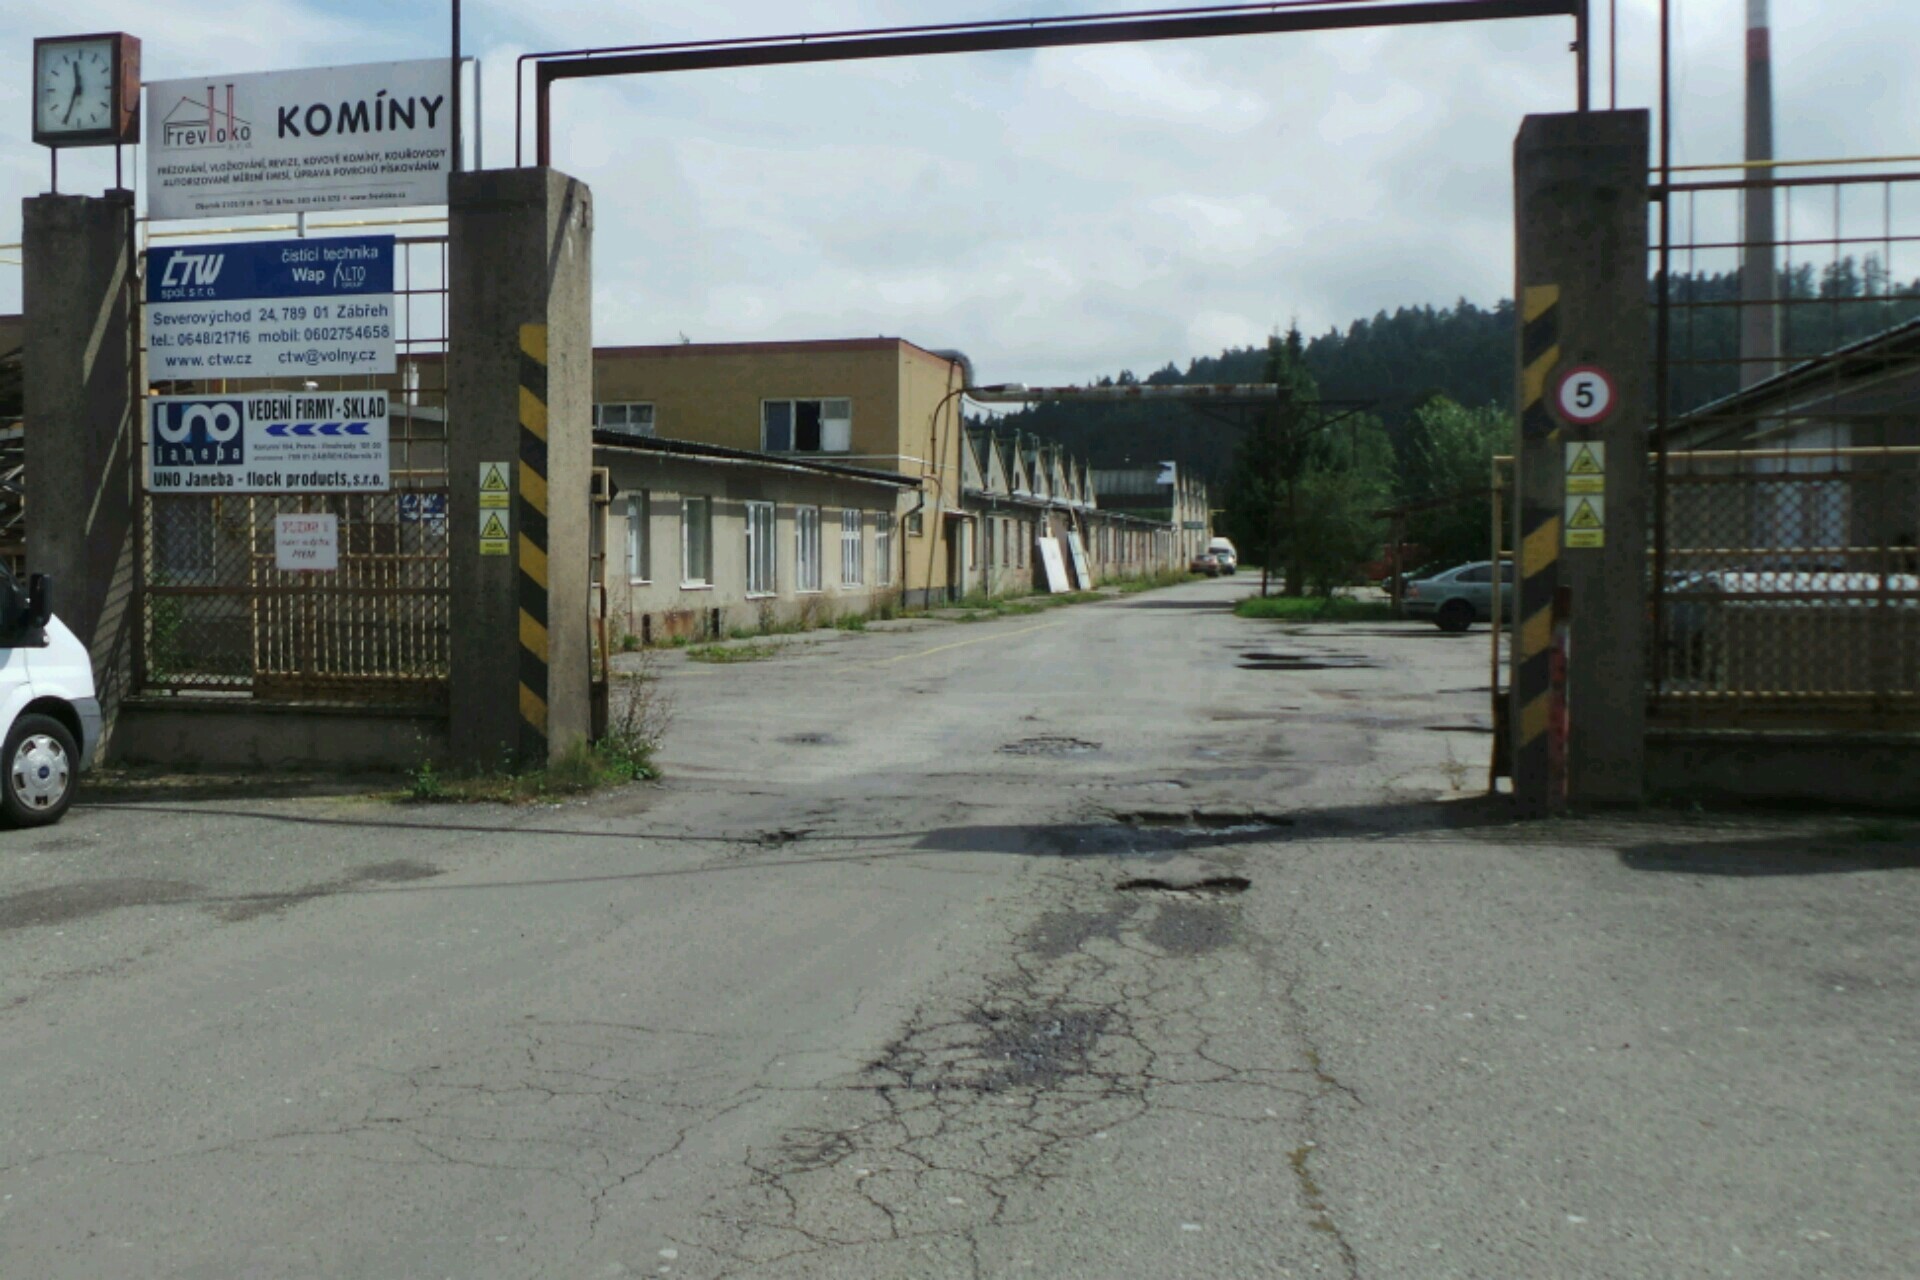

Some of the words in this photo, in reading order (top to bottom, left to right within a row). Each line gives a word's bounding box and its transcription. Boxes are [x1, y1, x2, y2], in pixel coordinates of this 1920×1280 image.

[278, 89, 444, 139] KOMÍNY
[343, 151, 382, 164] KOMÍNY,
[323, 244, 379, 261] technika
[292, 267, 326, 285] Wap
[153, 309, 252, 327] Severovýchod
[282, 306, 308, 321] 789
[313, 305, 330, 319] 01
[337, 303, 388, 319] Zábřeh
[177, 330, 251, 346] 0648/21716
[304, 324, 390, 341] 0602754658
[278, 347, 377, 366] ctw@volny.cz
[1576, 381, 1595, 409] 5
[248, 394, 293, 421] VEDENÍ
[296, 397, 334, 420] FIRMY
[343, 396, 387, 419] SKLAD
[153, 472, 181, 487] UNO
[185, 471, 234, 487] Janeba
